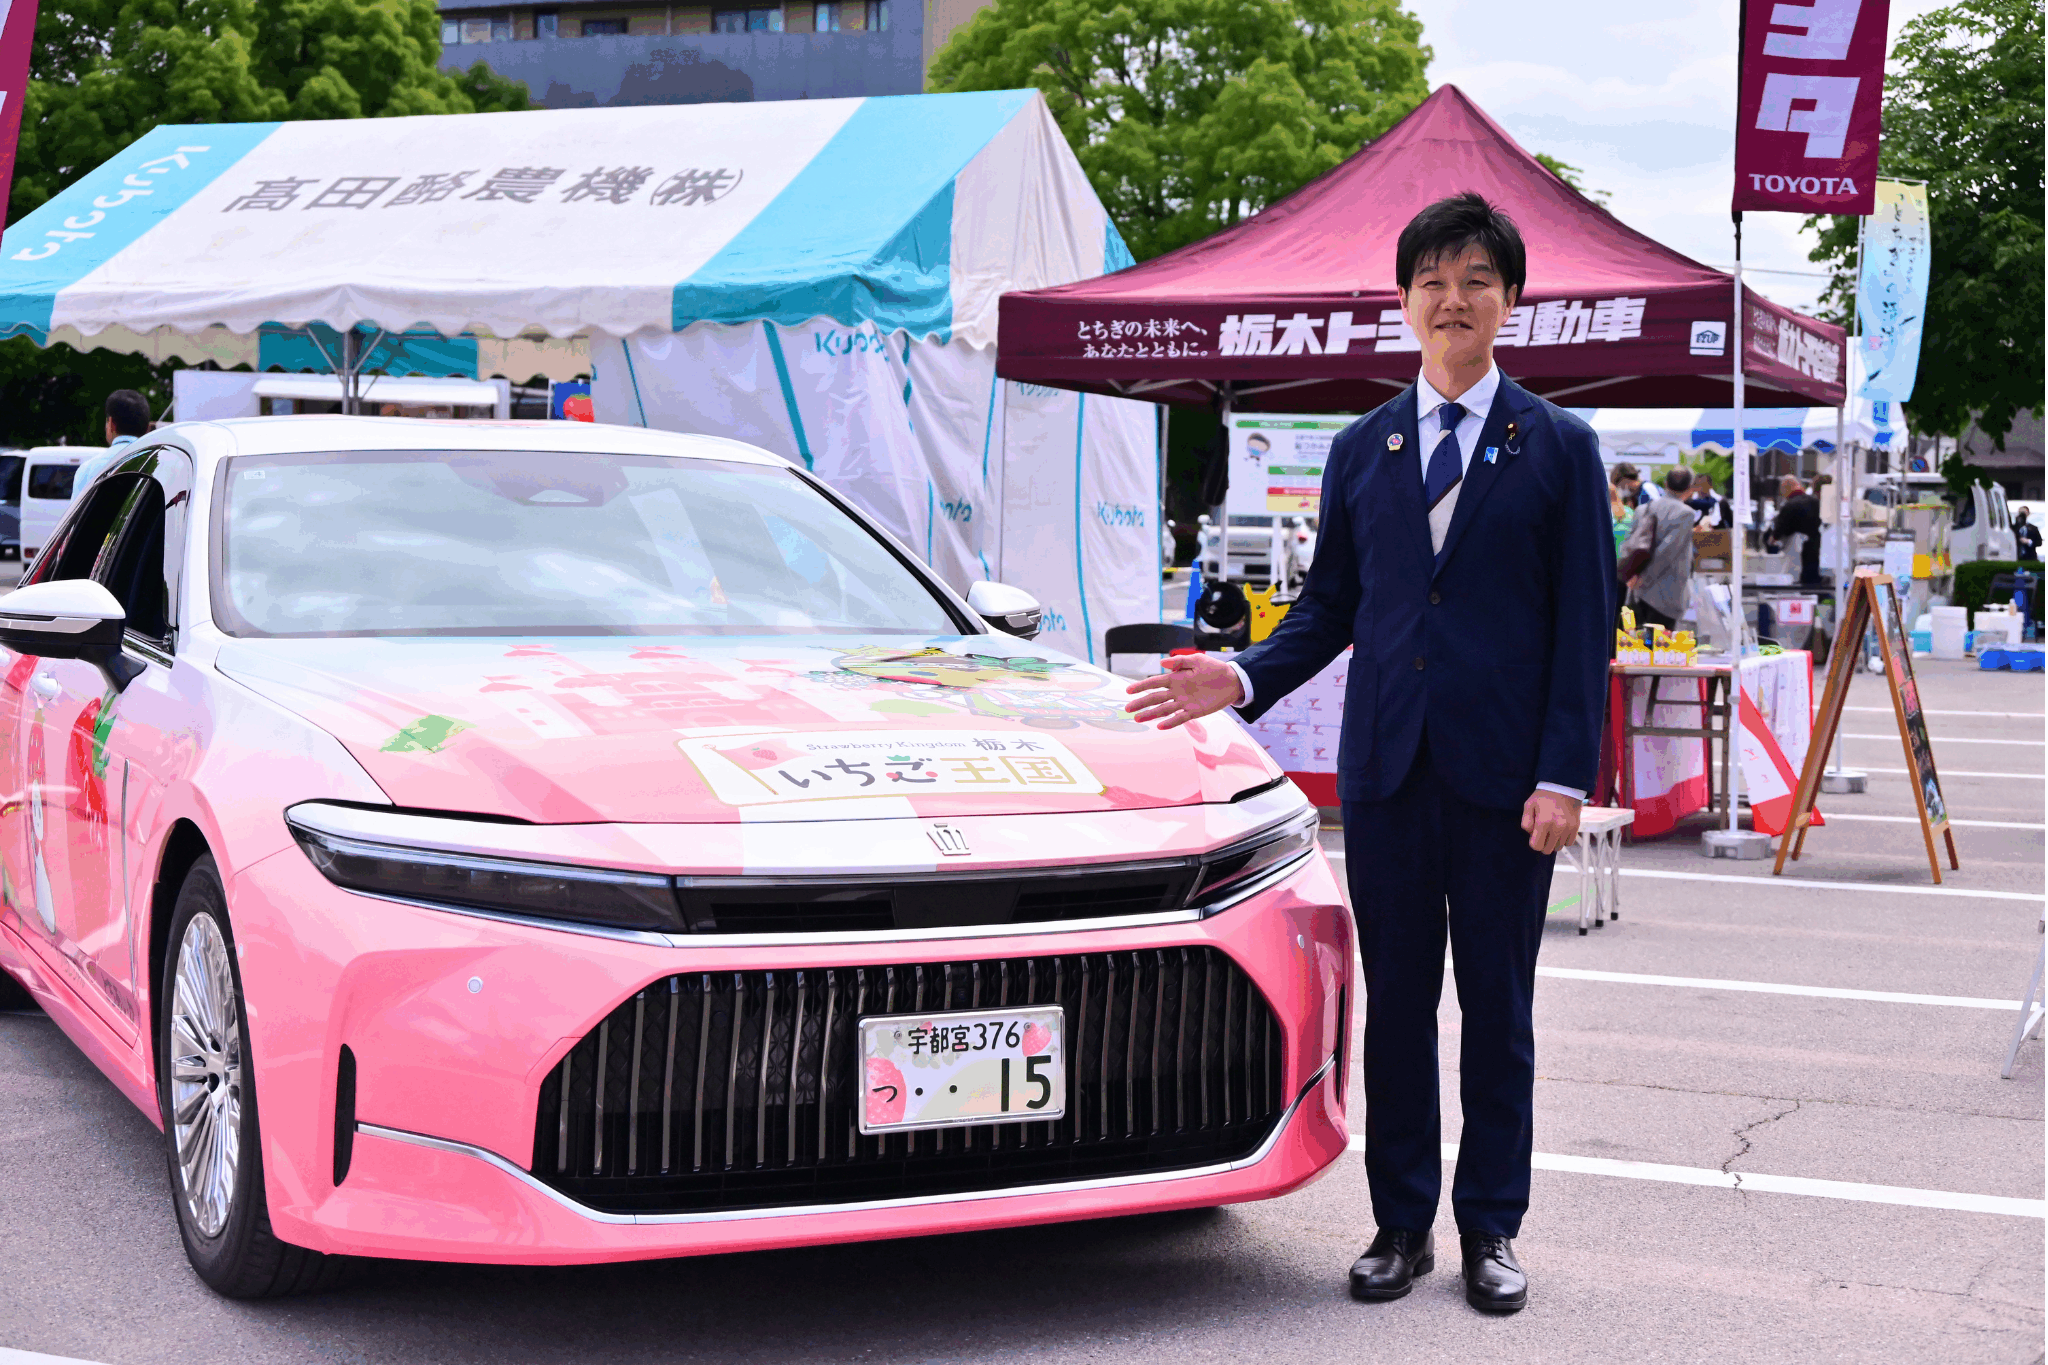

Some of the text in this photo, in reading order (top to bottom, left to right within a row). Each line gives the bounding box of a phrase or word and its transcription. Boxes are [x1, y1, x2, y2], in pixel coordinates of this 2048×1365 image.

[1748, 174, 1859, 195] TOYOTA
[1077, 318, 1208, 340] とちぎの未来へ、
[1082, 341, 1209, 358] あなたとともに。
[806, 742, 892, 750] Strawberry
[972, 738, 1045, 751] 栃木
[778, 754, 1077, 788] いちご王国
